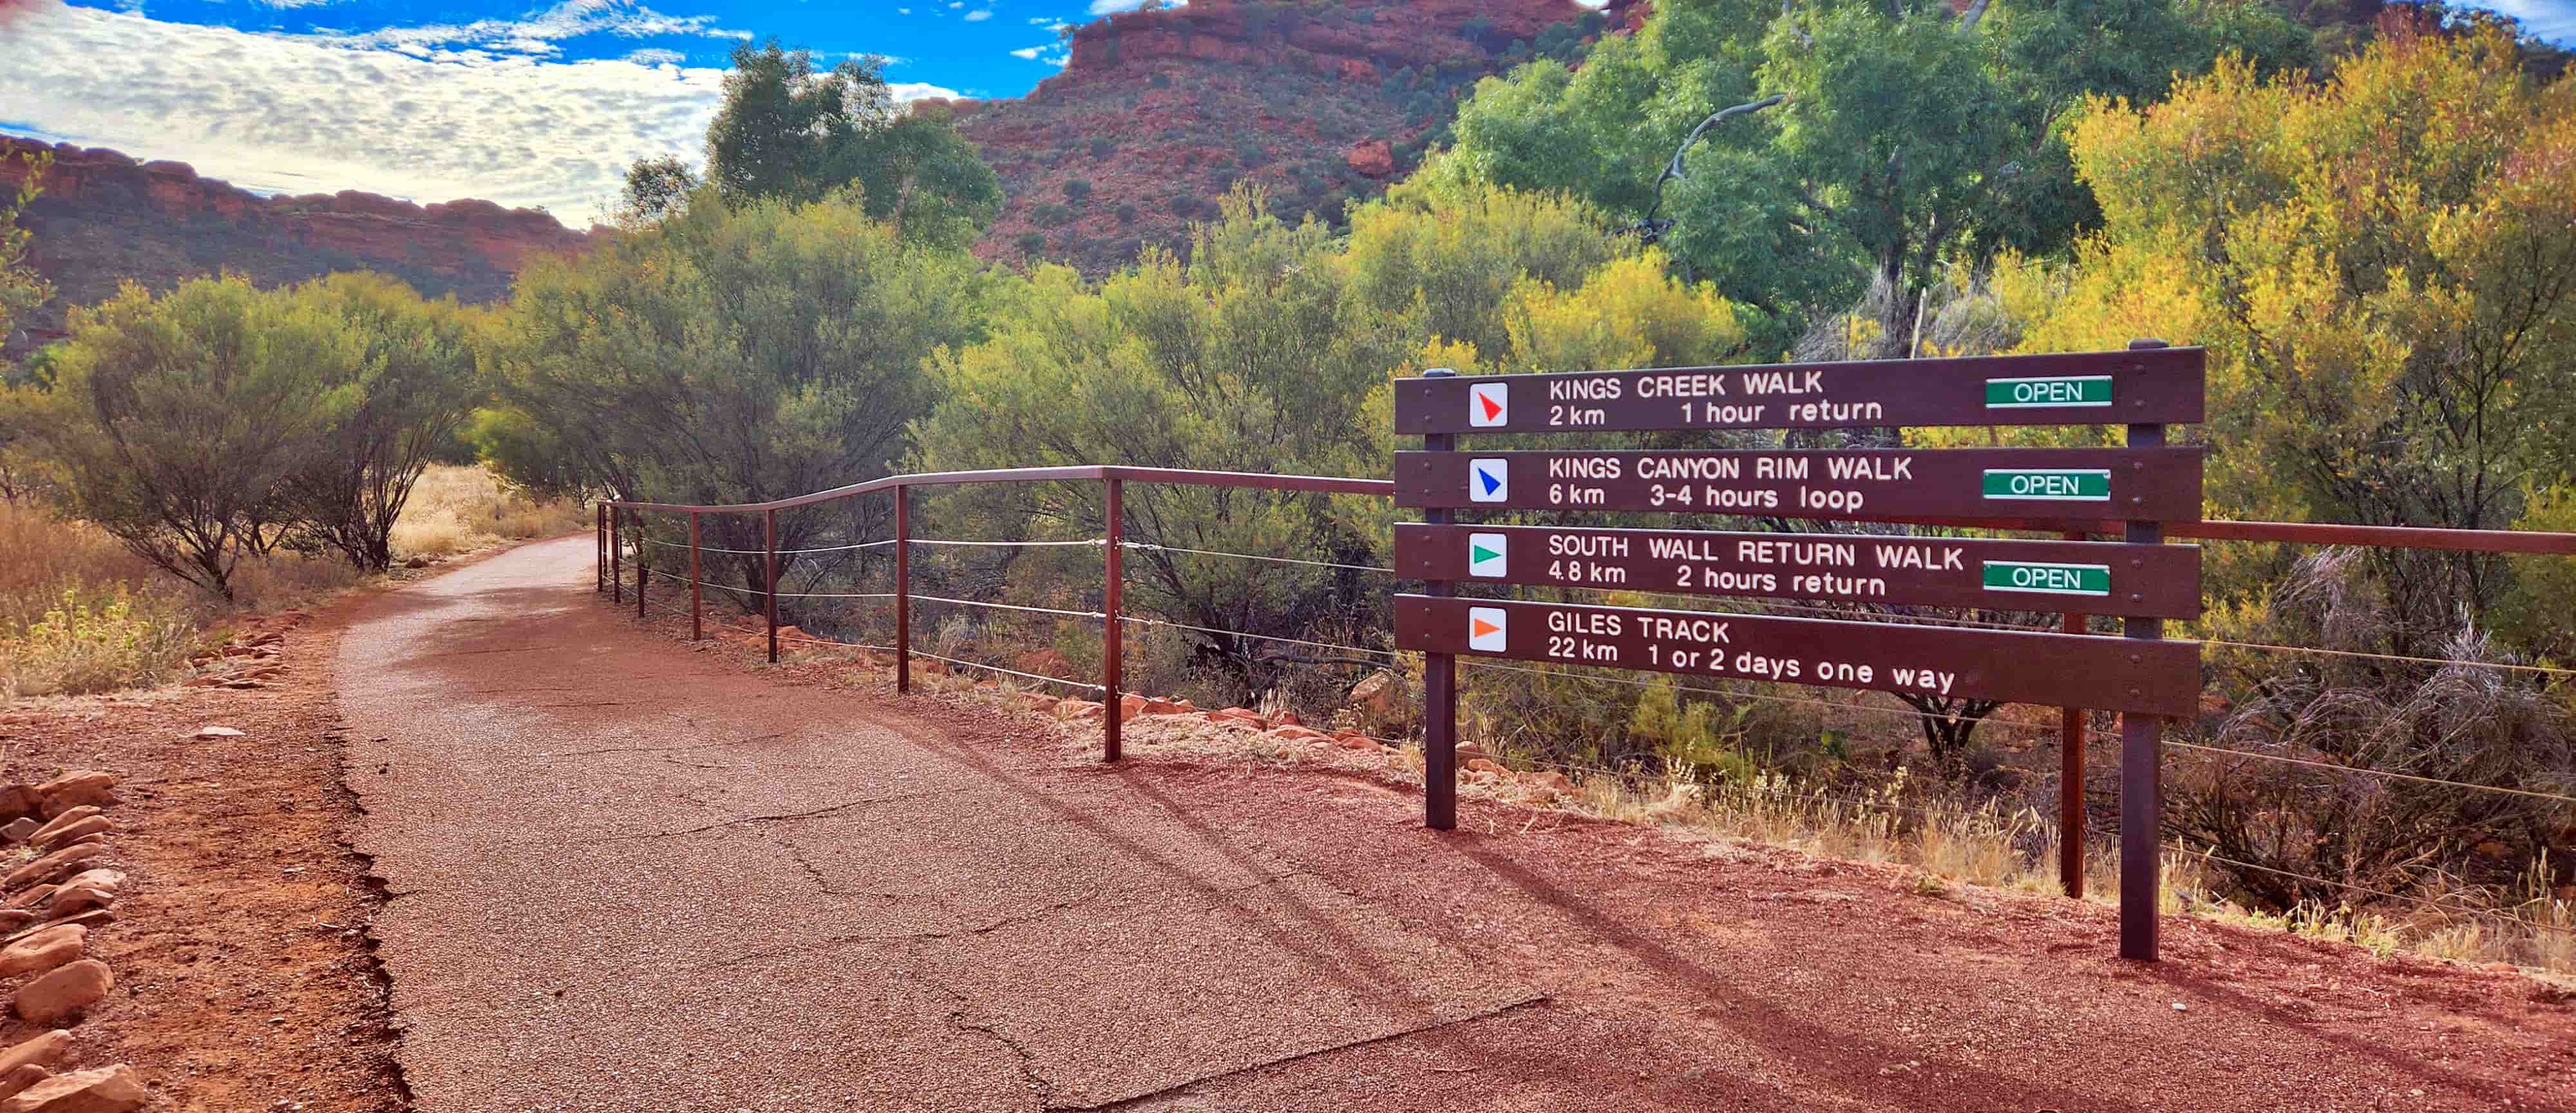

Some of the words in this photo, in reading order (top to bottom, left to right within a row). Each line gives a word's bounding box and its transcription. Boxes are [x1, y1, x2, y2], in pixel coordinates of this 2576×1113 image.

[1550, 377, 1621, 400] KINGS
[1638, 374, 1725, 398] CREEK
[1743, 370, 1823, 394] WALK
[2014, 382, 2082, 402] OPEN
[1549, 405, 1563, 426] 2
[1570, 405, 1605, 425] km
[1681, 403, 1691, 423] 1
[1707, 401, 1765, 423] hour
[1790, 399, 1882, 421] return
[1549, 457, 1621, 479] KINGS
[1637, 457, 1739, 479] CANYON
[1757, 457, 1808, 479] RIM
[1828, 457, 1912, 480] WALK
[1549, 484, 1562, 504] 6
[1570, 484, 1604, 504] km
[1651, 484, 1692, 506] 3-4
[1707, 485, 1778, 508] hours
[1801, 486, 1863, 513] loop
[2010, 475, 2079, 496] OPEN
[1549, 535, 1628, 557] SOUTH
[1649, 538, 1718, 560] WALL
[1739, 540, 1855, 566] RETURN
[1876, 545, 1964, 570] WALK
[1549, 560, 1581, 581] 4.8
[1591, 562, 1625, 583] km
[1677, 565, 1691, 586] 2
[1705, 567, 1776, 591] hours
[1794, 573, 1885, 595] return
[2012, 567, 2081, 590] OPEN
[1548, 611, 1621, 636] GILES
[1638, 617, 1730, 643] TRACK
[1548, 636, 1575, 658] 22
[1583, 639, 1617, 661] km
[1649, 645, 1658, 664] 1
[1672, 651, 1699, 667] or
[1710, 649, 1724, 671] 2
[1736, 652, 1800, 680] days
[1817, 662, 1873, 683] one
[1893, 669, 1955, 694] way
